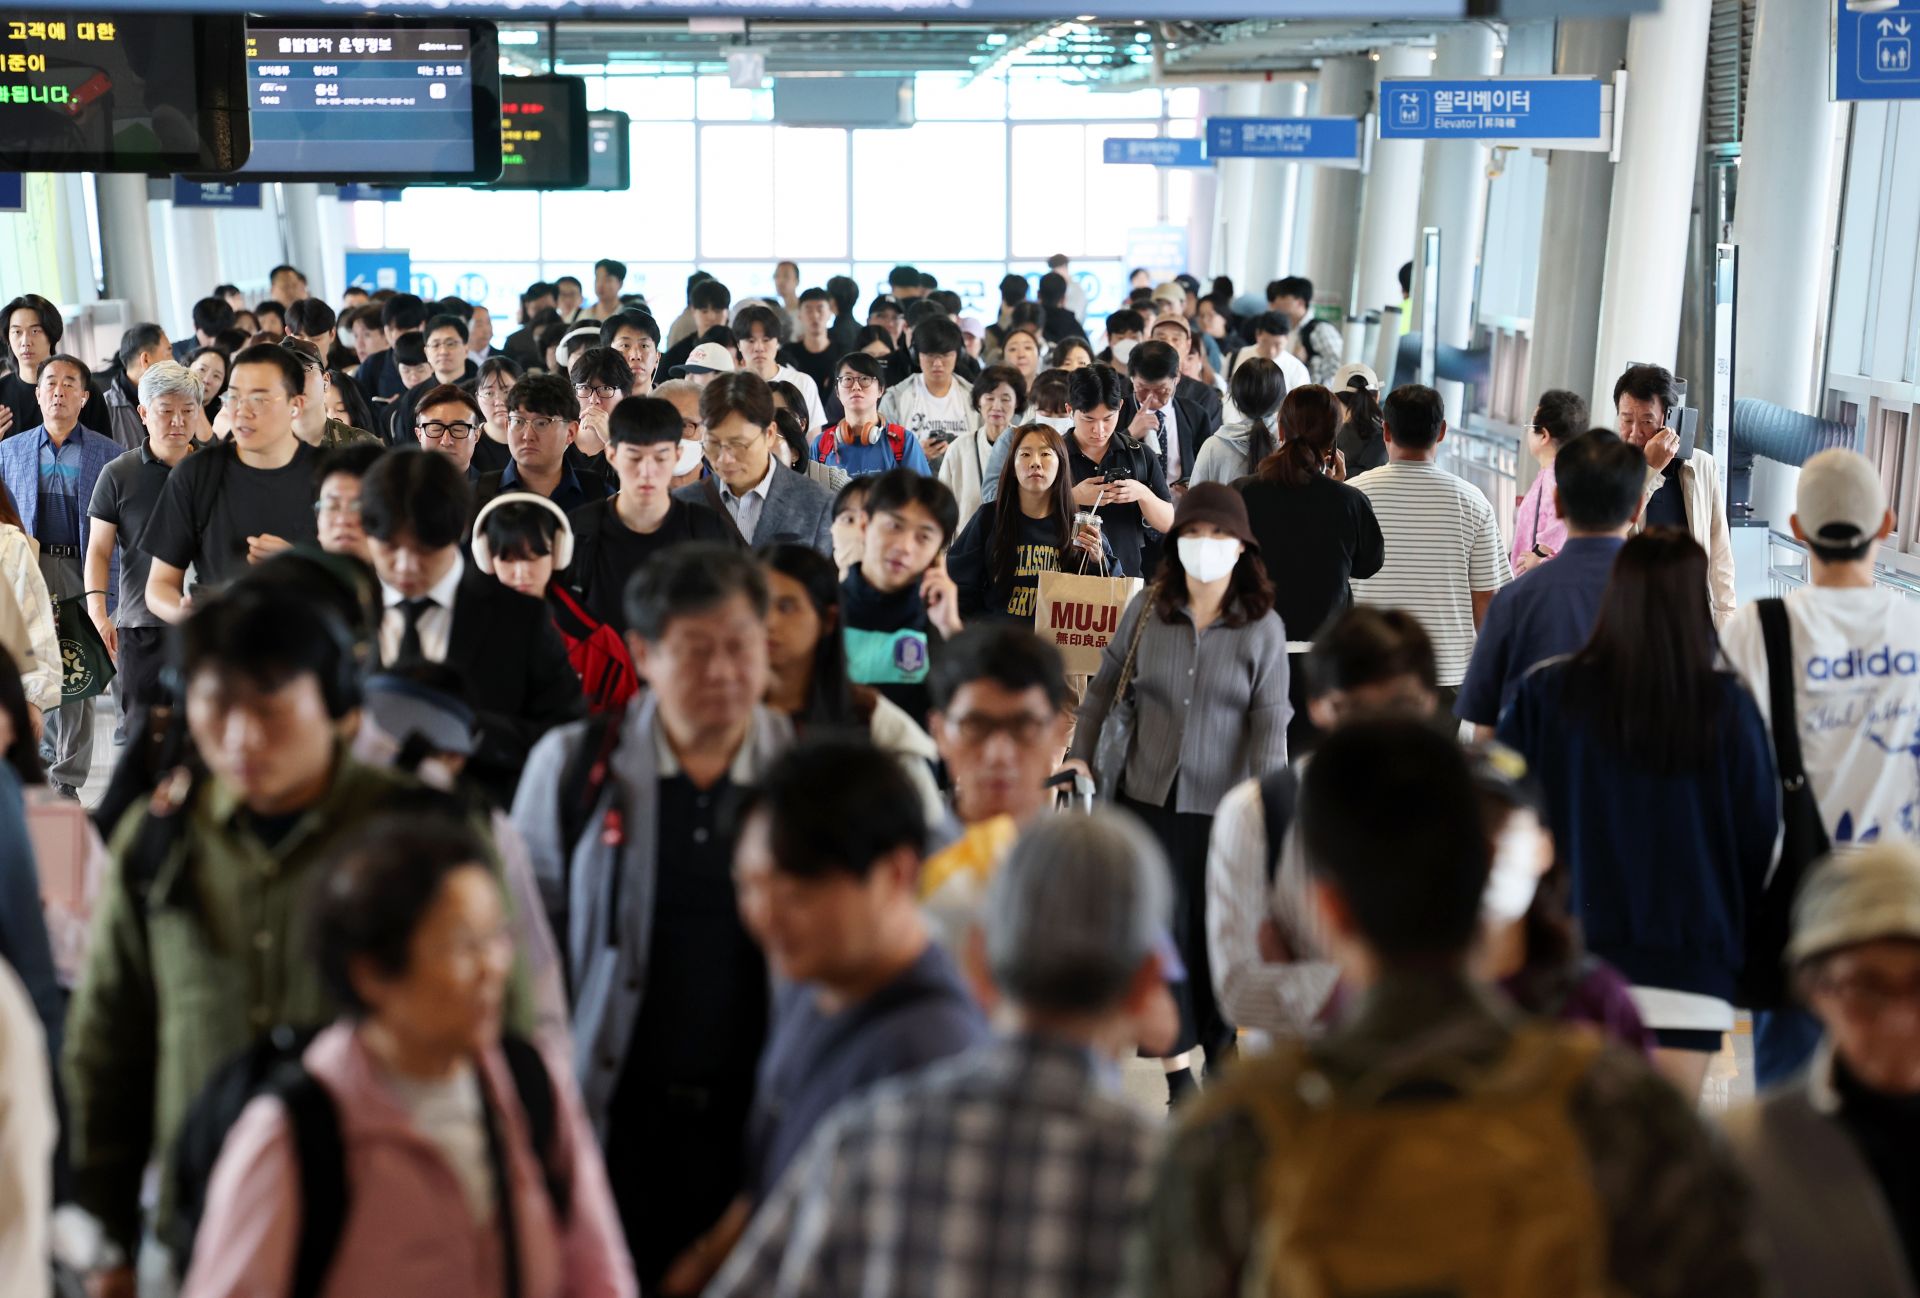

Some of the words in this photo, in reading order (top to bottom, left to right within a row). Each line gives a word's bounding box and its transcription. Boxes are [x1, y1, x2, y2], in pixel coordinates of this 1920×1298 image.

[8, 22, 66, 40] 고객에
[77, 22, 116, 40] 대한
[1434, 90, 1530, 112] 엘리베이터
[1434, 117, 1476, 129] Elevator
[1050, 601, 1118, 633] MUJI
[1055, 631, 1109, 648] 無印良品
